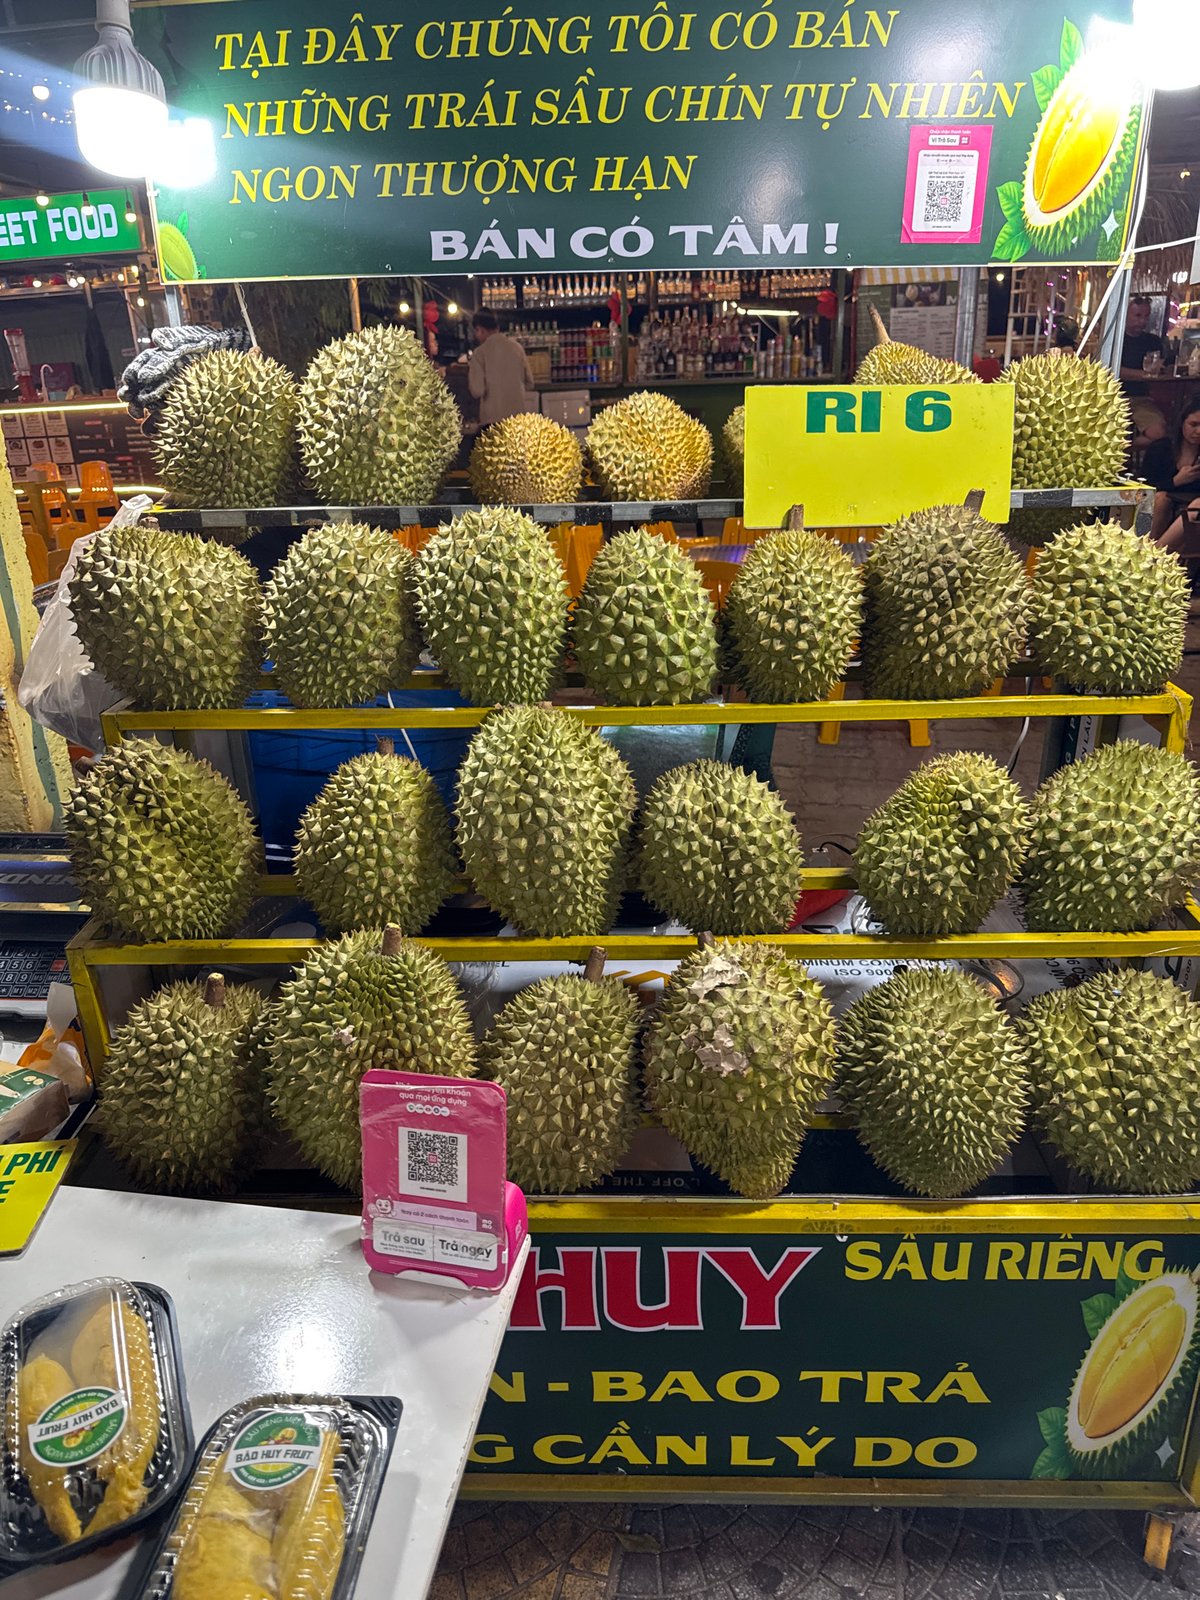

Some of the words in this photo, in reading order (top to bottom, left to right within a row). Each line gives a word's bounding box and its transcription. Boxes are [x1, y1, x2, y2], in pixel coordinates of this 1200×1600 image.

[215, 29, 293, 80] TẠI
[303, 13, 404, 65] ĐÂY
[415, 6, 594, 60] CHÚNG
[607, 1, 698, 54] TÔI
[708, 3, 780, 51] CÓ
[788, 2, 899, 50] BÁN
[221, 88, 393, 140] NHỮNG
[406, 79, 519, 129] TRÁI
[531, 68, 631, 126] SẦU
[644, 73, 774, 122] CHÍN
[784, 76, 858, 130] TỰ
[858, 68, 1027, 120] NHIÊN
[229, 164, 362, 204] NGON
[373, 153, 579, 206] THƯỢNG
[590, 154, 698, 202] HẠN
[46, 203, 119, 243] FOOD
[430, 219, 557, 261] BÁN
[569, 216, 656, 260] CÓ
[667, 216, 810, 257] TÂM
[805, 390, 883, 434] RI
[904, 390, 953, 433] 6
[20, 973, 28, 982] 9
[26, 961, 34, 969] 6
[834, 968, 862, 976] ISO
[866, 968, 893, 976] 900
[2, 1144, 67, 1176] PHÍ
[381, 1230, 402, 1243] Trả
[403, 1235, 426, 1247] sau
[438, 1238, 459, 1252] Trả
[461, 1243, 493, 1259] ngay
[983, 1233, 1166, 1282] RIÊNG
[507, 1246, 824, 1333] HUY
[590, 1370, 781, 1403] BAO
[798, 1361, 992, 1404] TRẢ
[260, 1449, 283, 1460] HUY
[283, 1448, 315, 1461] FRUIT
[532, 1420, 708, 1466] CẦN
[729, 1425, 836, 1468] LÝ
[853, 1436, 978, 1469] DO
